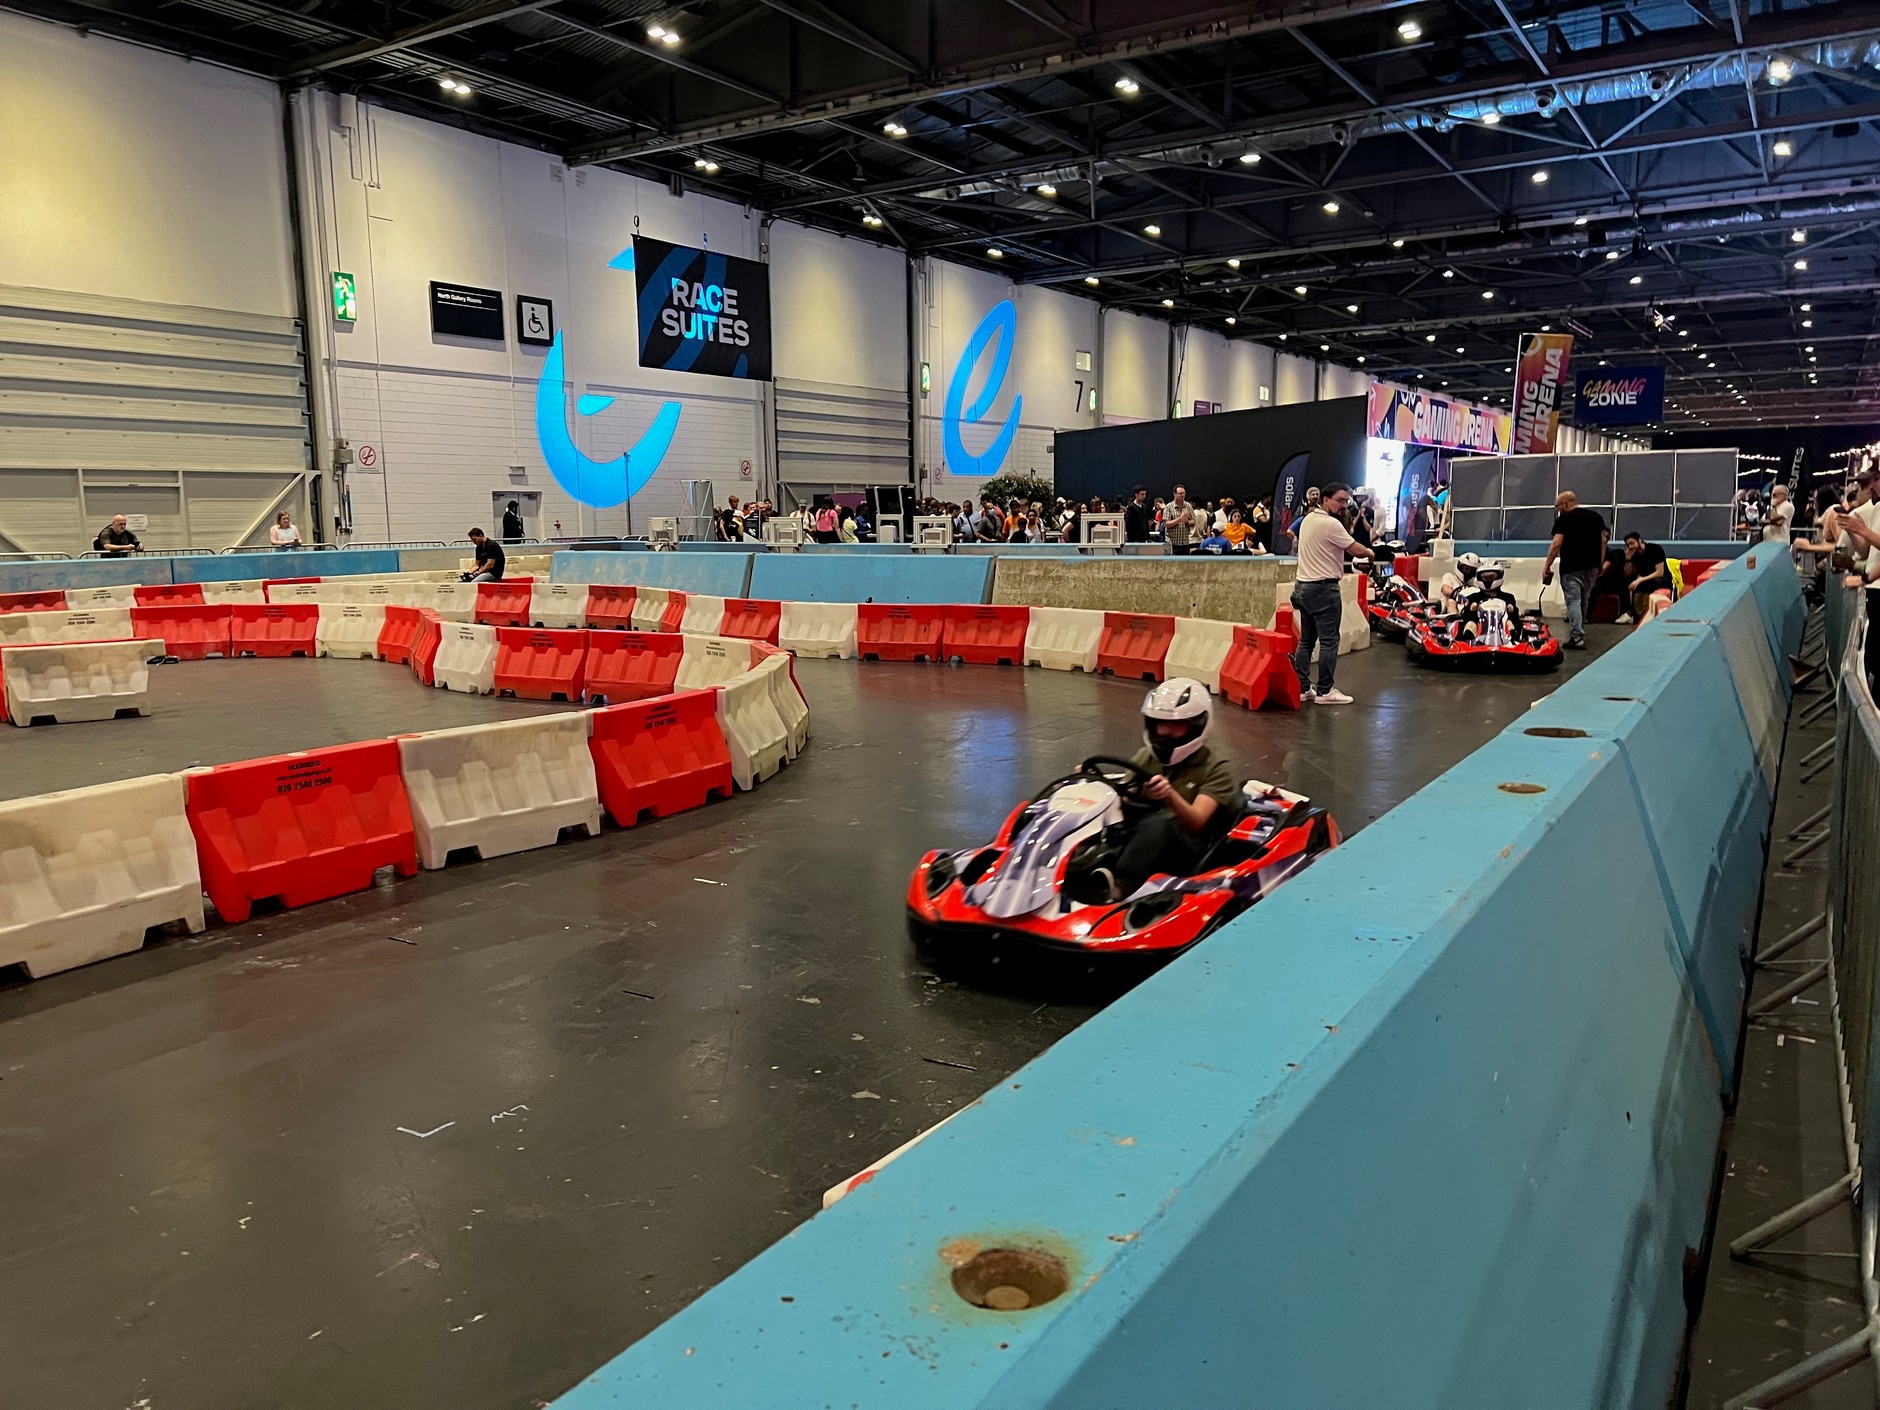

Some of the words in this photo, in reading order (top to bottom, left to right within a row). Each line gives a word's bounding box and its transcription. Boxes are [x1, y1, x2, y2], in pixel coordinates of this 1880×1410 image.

[437, 292, 451, 300] North
[671, 277, 739, 316] RACE
[661, 308, 750, 347] SUITES
[1074, 380, 1084, 413] 7
[1533, 348, 1563, 444] ARENA
[1582, 377, 1647, 399] GAMING
[1589, 391, 1637, 407] ZONE
[1413, 401, 1460, 442] GAMING
[1459, 413, 1495, 452] ARENA
[1788, 446, 1805, 490] SUITES
[1284, 476, 1295, 509] solar
[1411, 473, 1421, 508] solar
